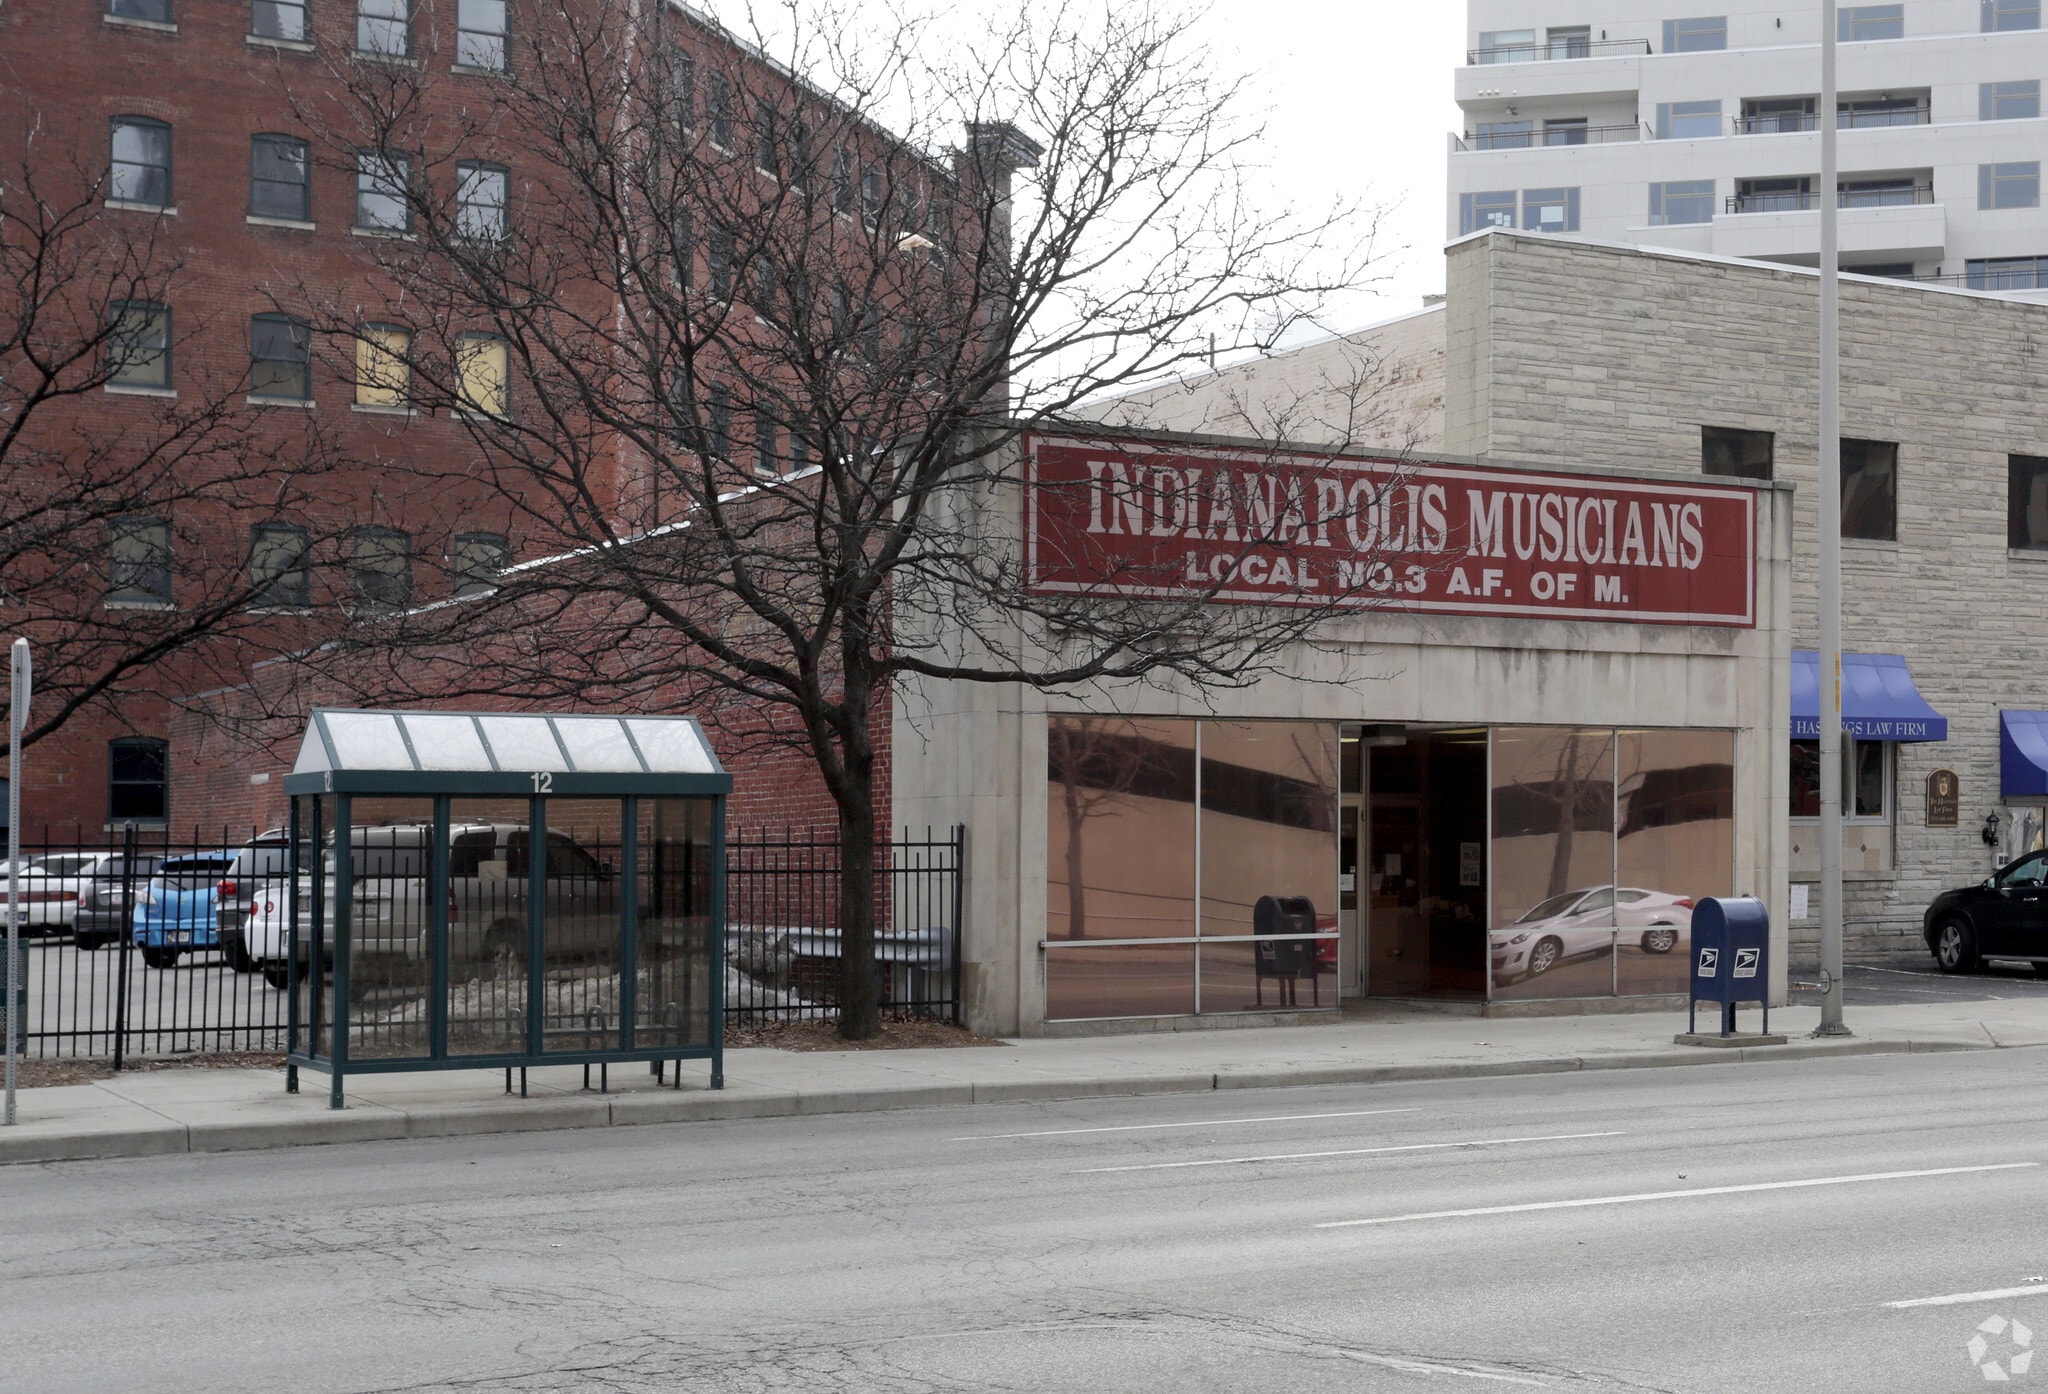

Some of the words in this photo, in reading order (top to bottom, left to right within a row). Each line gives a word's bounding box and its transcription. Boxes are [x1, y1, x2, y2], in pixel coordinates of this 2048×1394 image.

[1086, 460, 1447, 555] INDIANAPOLIS
[1466, 489, 1703, 570] MUSICIANS
[1186, 551, 1319, 588] LOCAL
[1338, 559, 1427, 594] NO.3
[1446, 566, 1512, 597] A.F.
[1529, 571, 1577, 600] OF
[1594, 574, 1629, 603] M.
[1866, 722, 1893, 736] LAW
[1895, 722, 1926, 736] FIRM
[530, 771, 552, 793] 12
